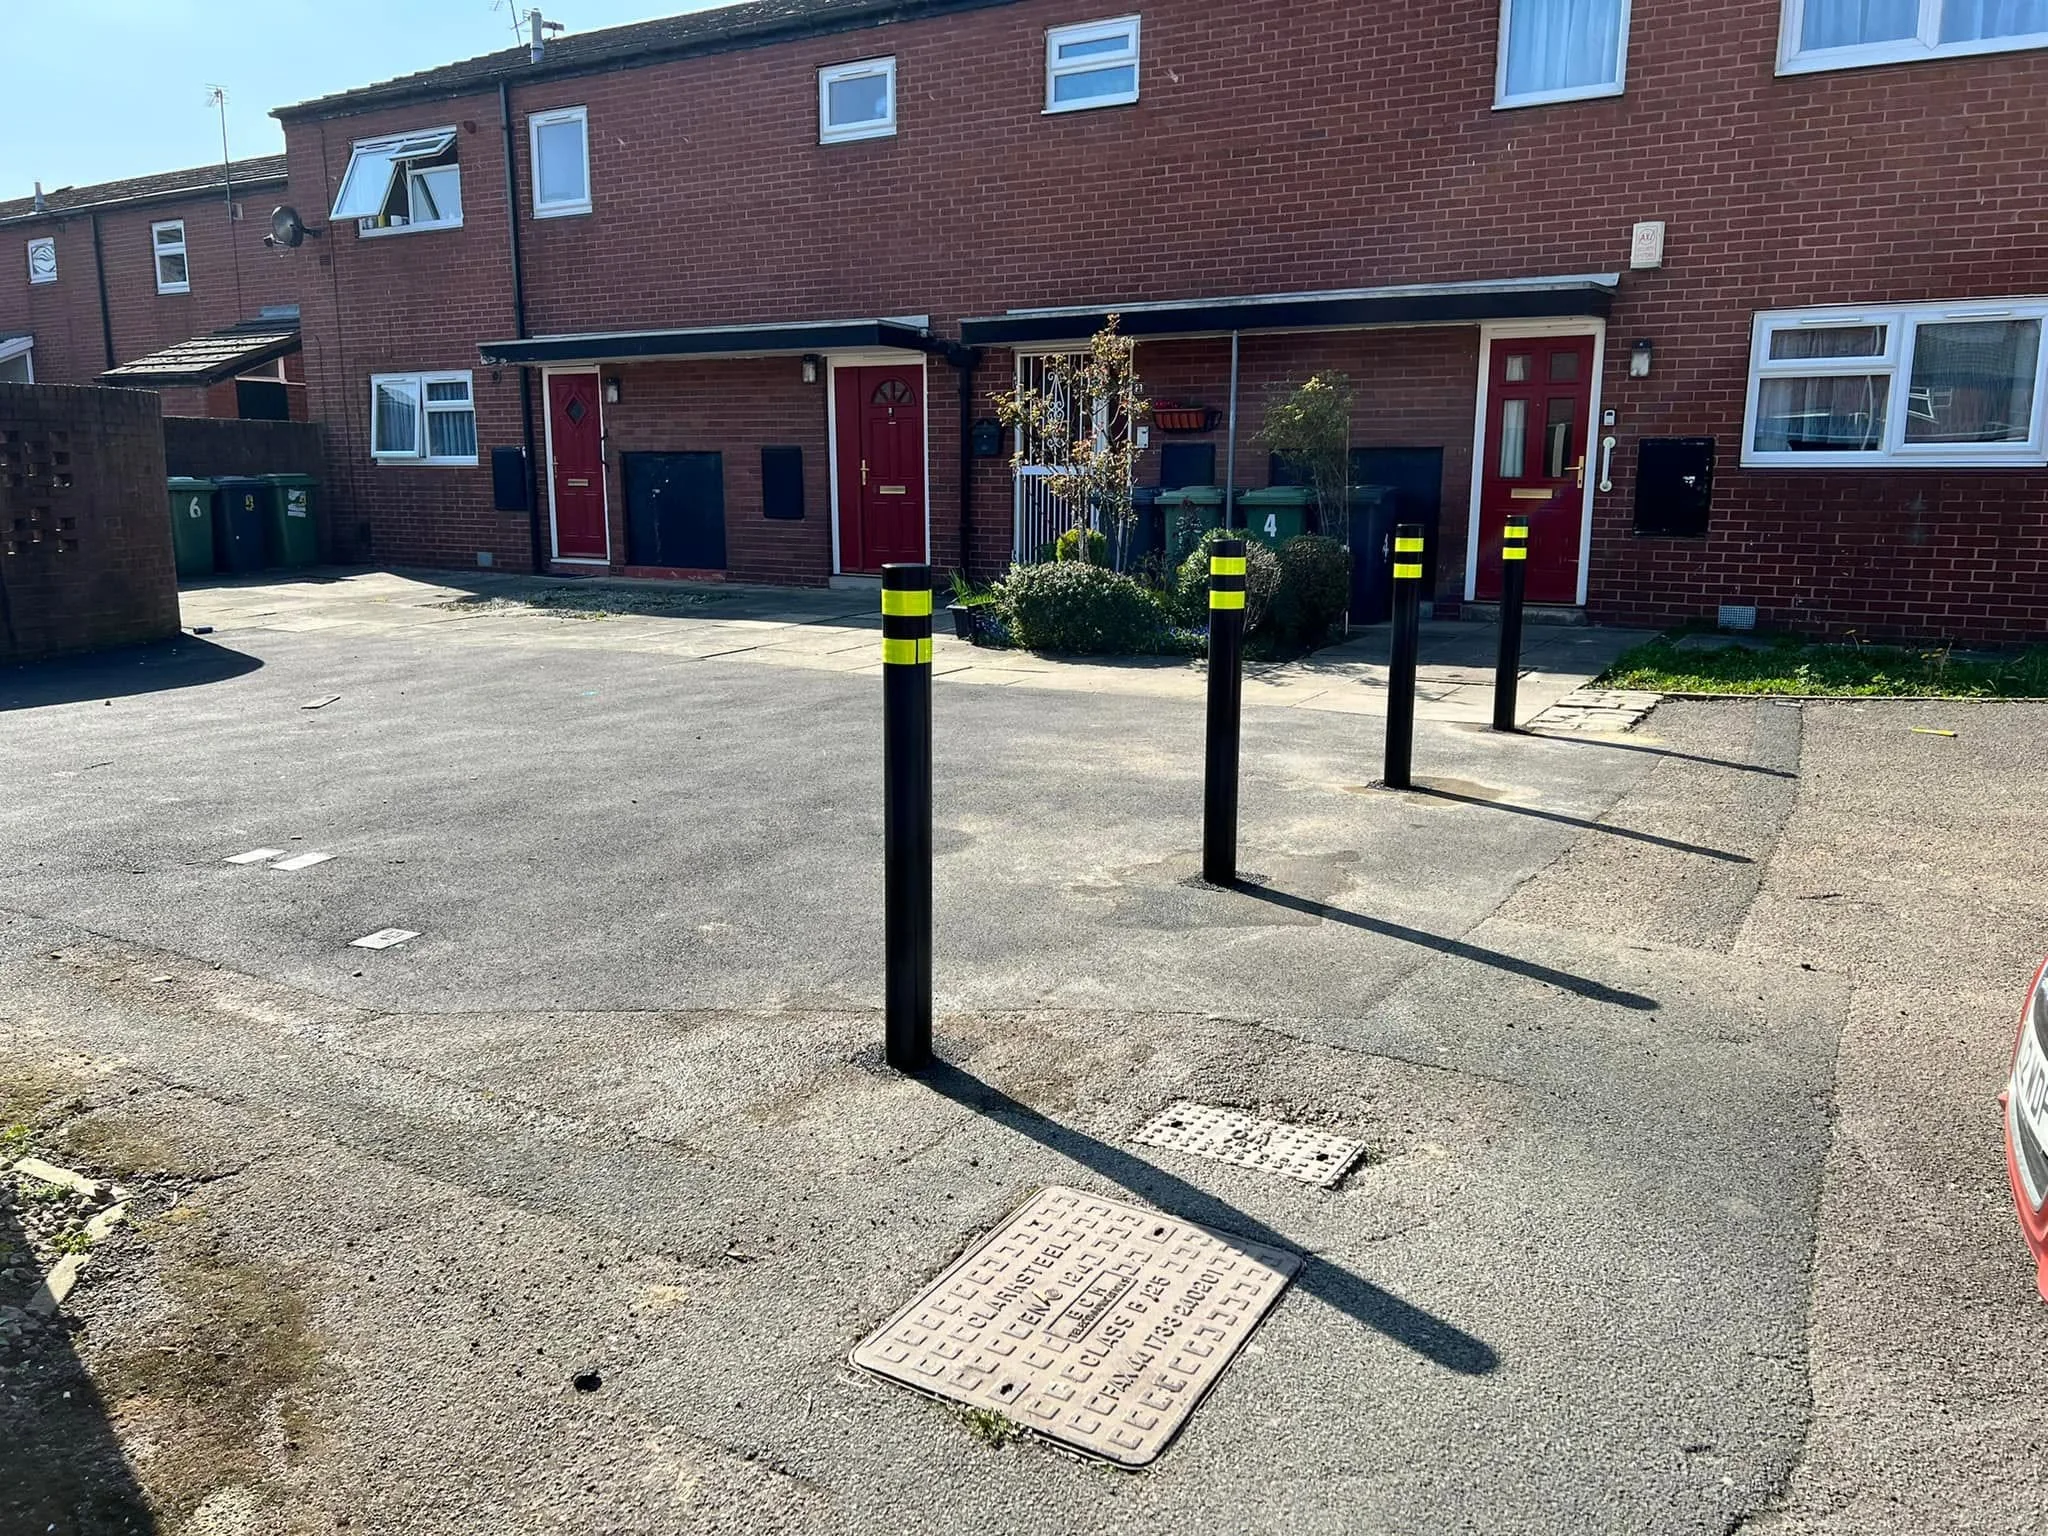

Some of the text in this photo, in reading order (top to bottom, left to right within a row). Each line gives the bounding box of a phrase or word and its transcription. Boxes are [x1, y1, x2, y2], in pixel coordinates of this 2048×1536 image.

[190, 496, 201, 518] 6
[1264, 514, 1277, 537] 4
[962, 1238, 1074, 1330] CLARKSTEEL
[1016, 1262, 1094, 1325] EN 124
[1075, 1275, 1173, 1368] CLASS B 125
[1096, 1267, 1226, 1400] FAX 44 1733 240201
